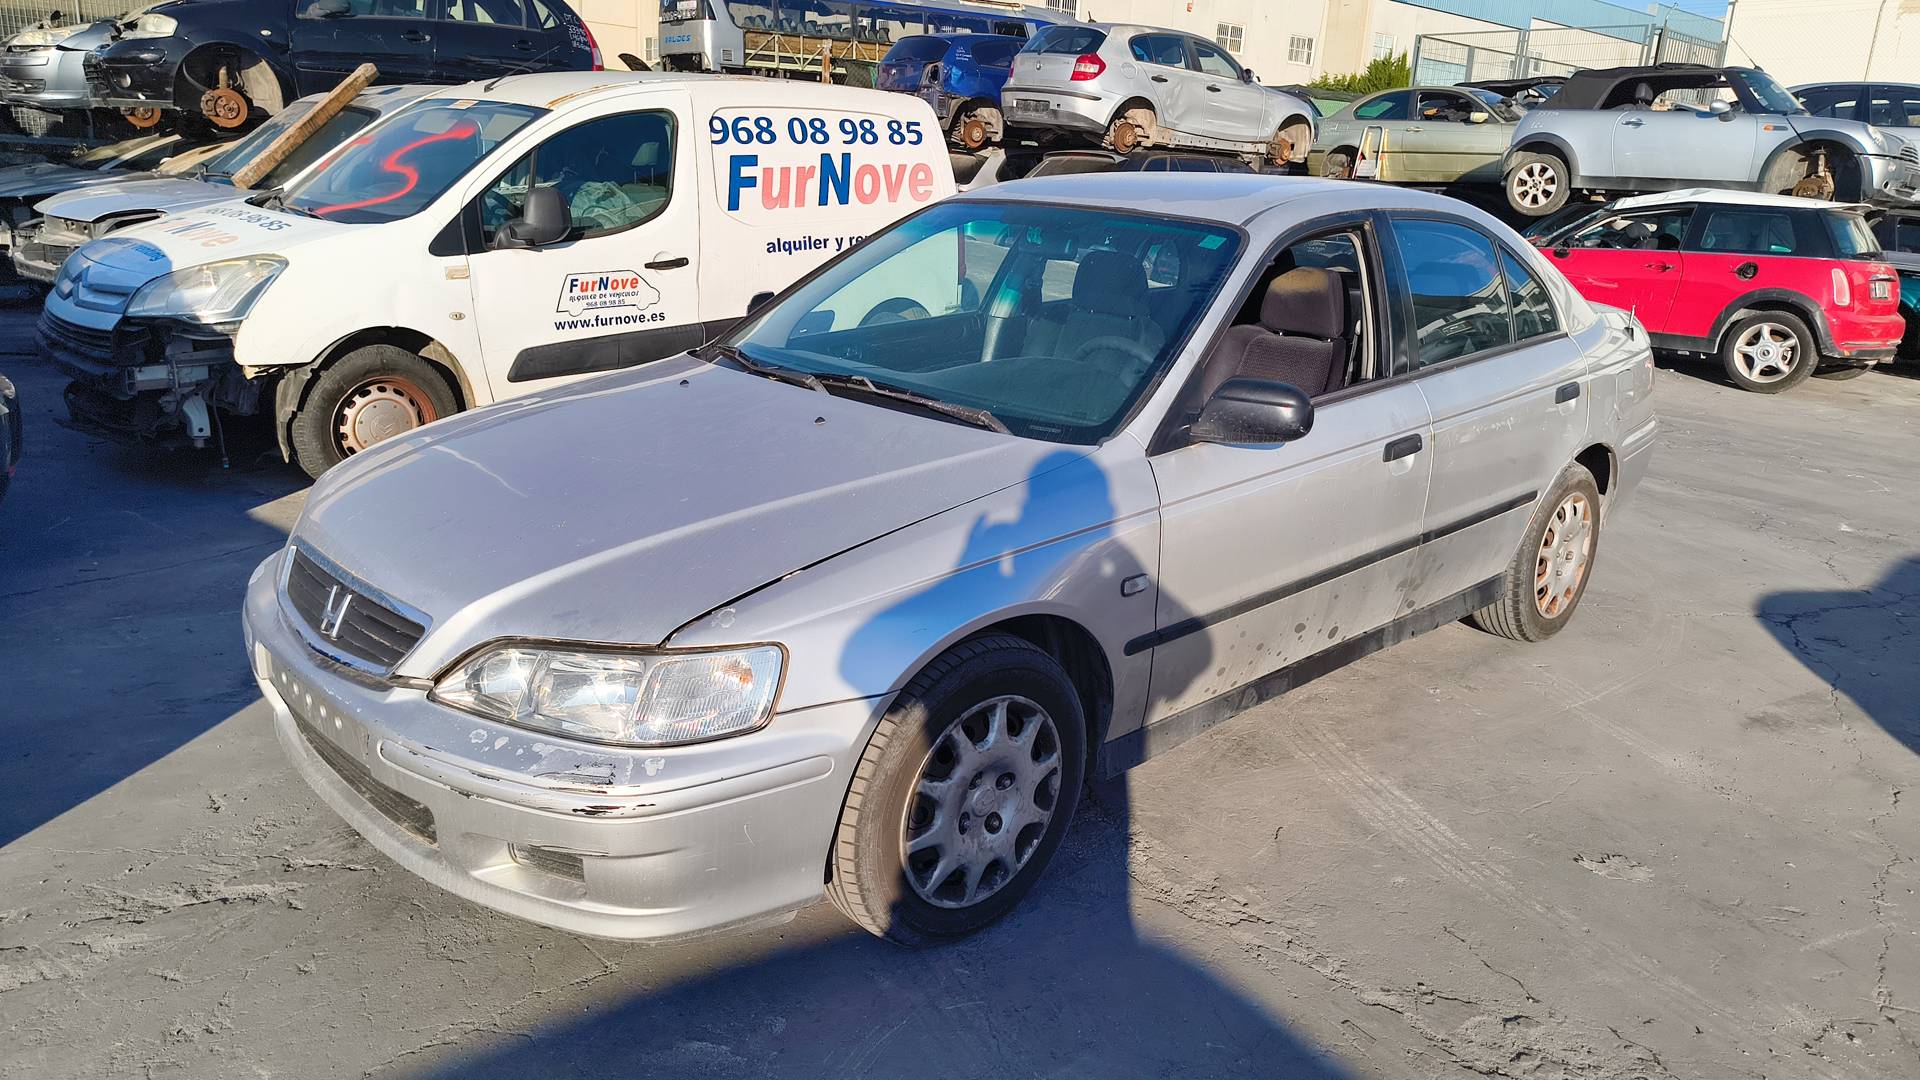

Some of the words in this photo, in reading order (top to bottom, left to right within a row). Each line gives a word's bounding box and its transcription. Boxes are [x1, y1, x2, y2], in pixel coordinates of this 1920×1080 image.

[708, 116, 777, 145] 968
[787, 117, 830, 145] 08
[838, 118, 879, 145] 98
[887, 120, 924, 146] 85
[727, 153, 934, 212] FurNove
[259, 219, 292, 231] 85
[766, 235, 830, 256] alquiler
[835, 236, 844, 251] y
[569, 276, 639, 294] FurNove
[554, 311, 666, 331] www.furnove.es
